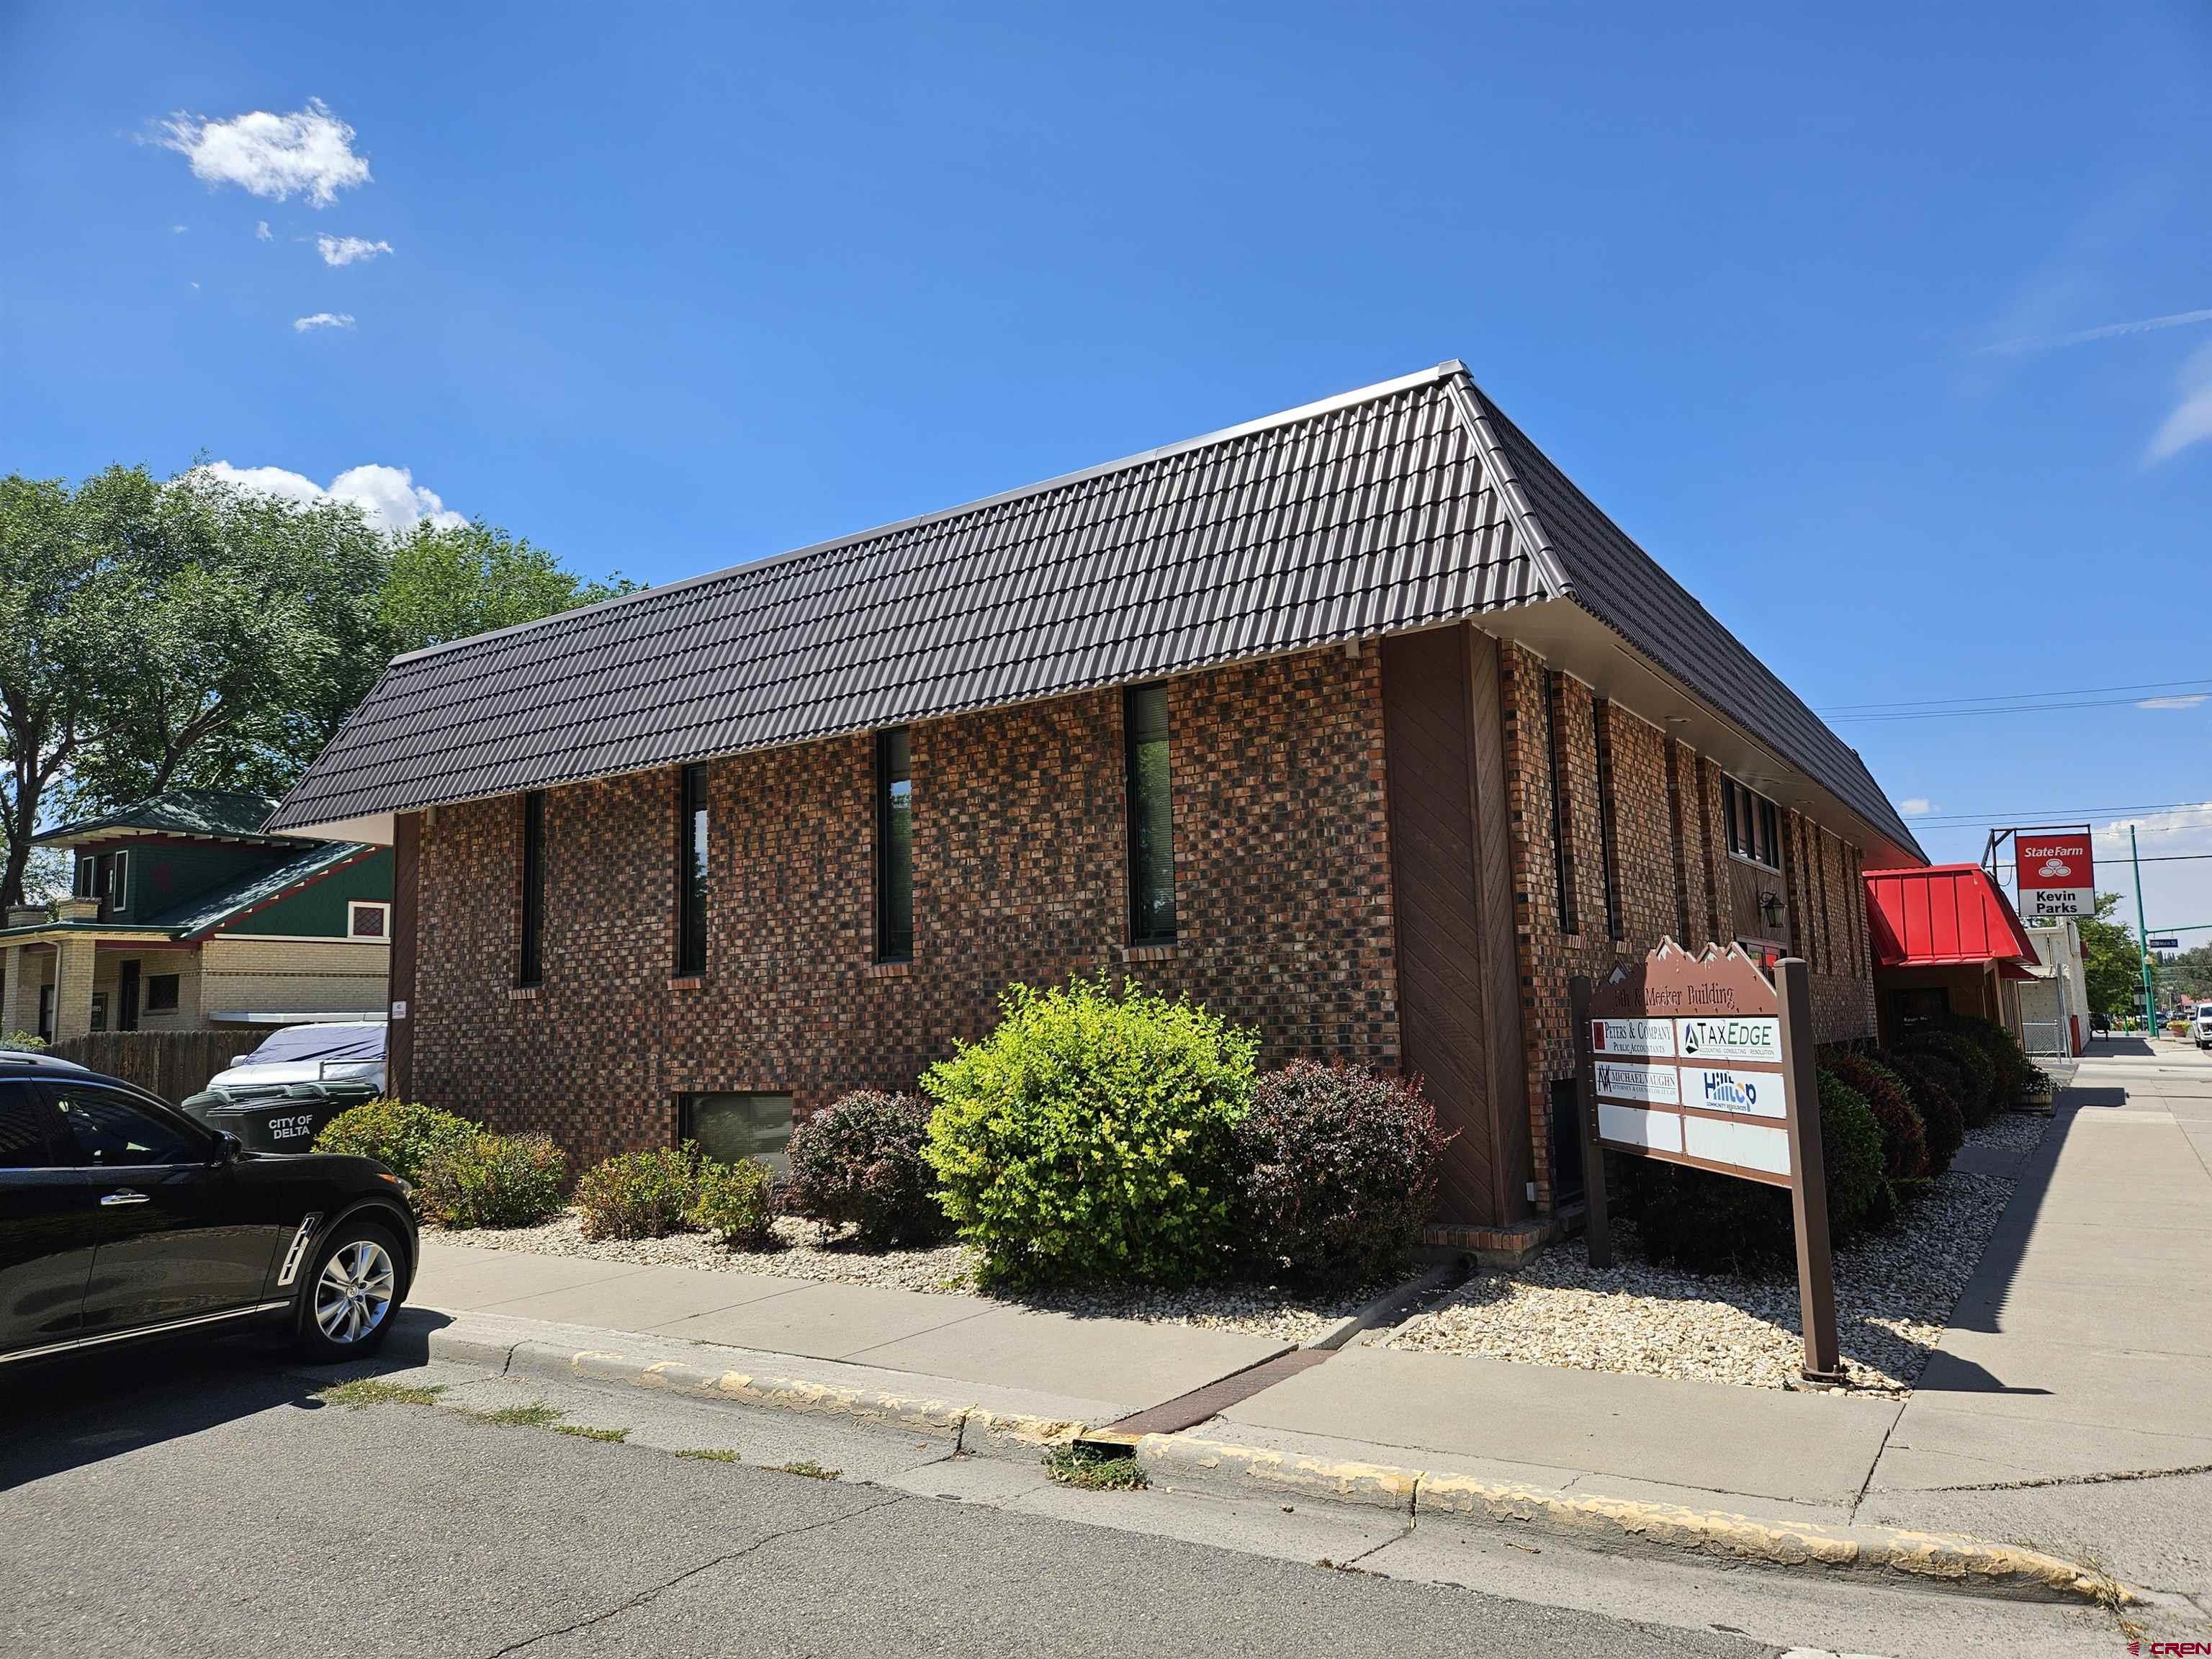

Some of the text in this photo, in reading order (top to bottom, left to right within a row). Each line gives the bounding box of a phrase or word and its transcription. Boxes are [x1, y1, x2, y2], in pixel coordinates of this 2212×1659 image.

[2036, 890, 2076, 902] Kevin
[2036, 902, 2077, 914] Parks
[1614, 989, 1629, 1007] 5th
[1645, 986, 1683, 1007] Meeker
[1687, 982, 1735, 1010] Building
[1605, 1022, 1671, 1040] PETERS & COMPANY
[1613, 1042, 1629, 1052] PUBLIC
[1612, 1071, 1644, 1084] MICHAEL
[1643, 1074, 1676, 1087] VAUGHN
[1704, 1071, 1757, 1109] Hilltop
[269, 1114, 313, 1129] CITY OF
[274, 1125, 310, 1140] DELTA
